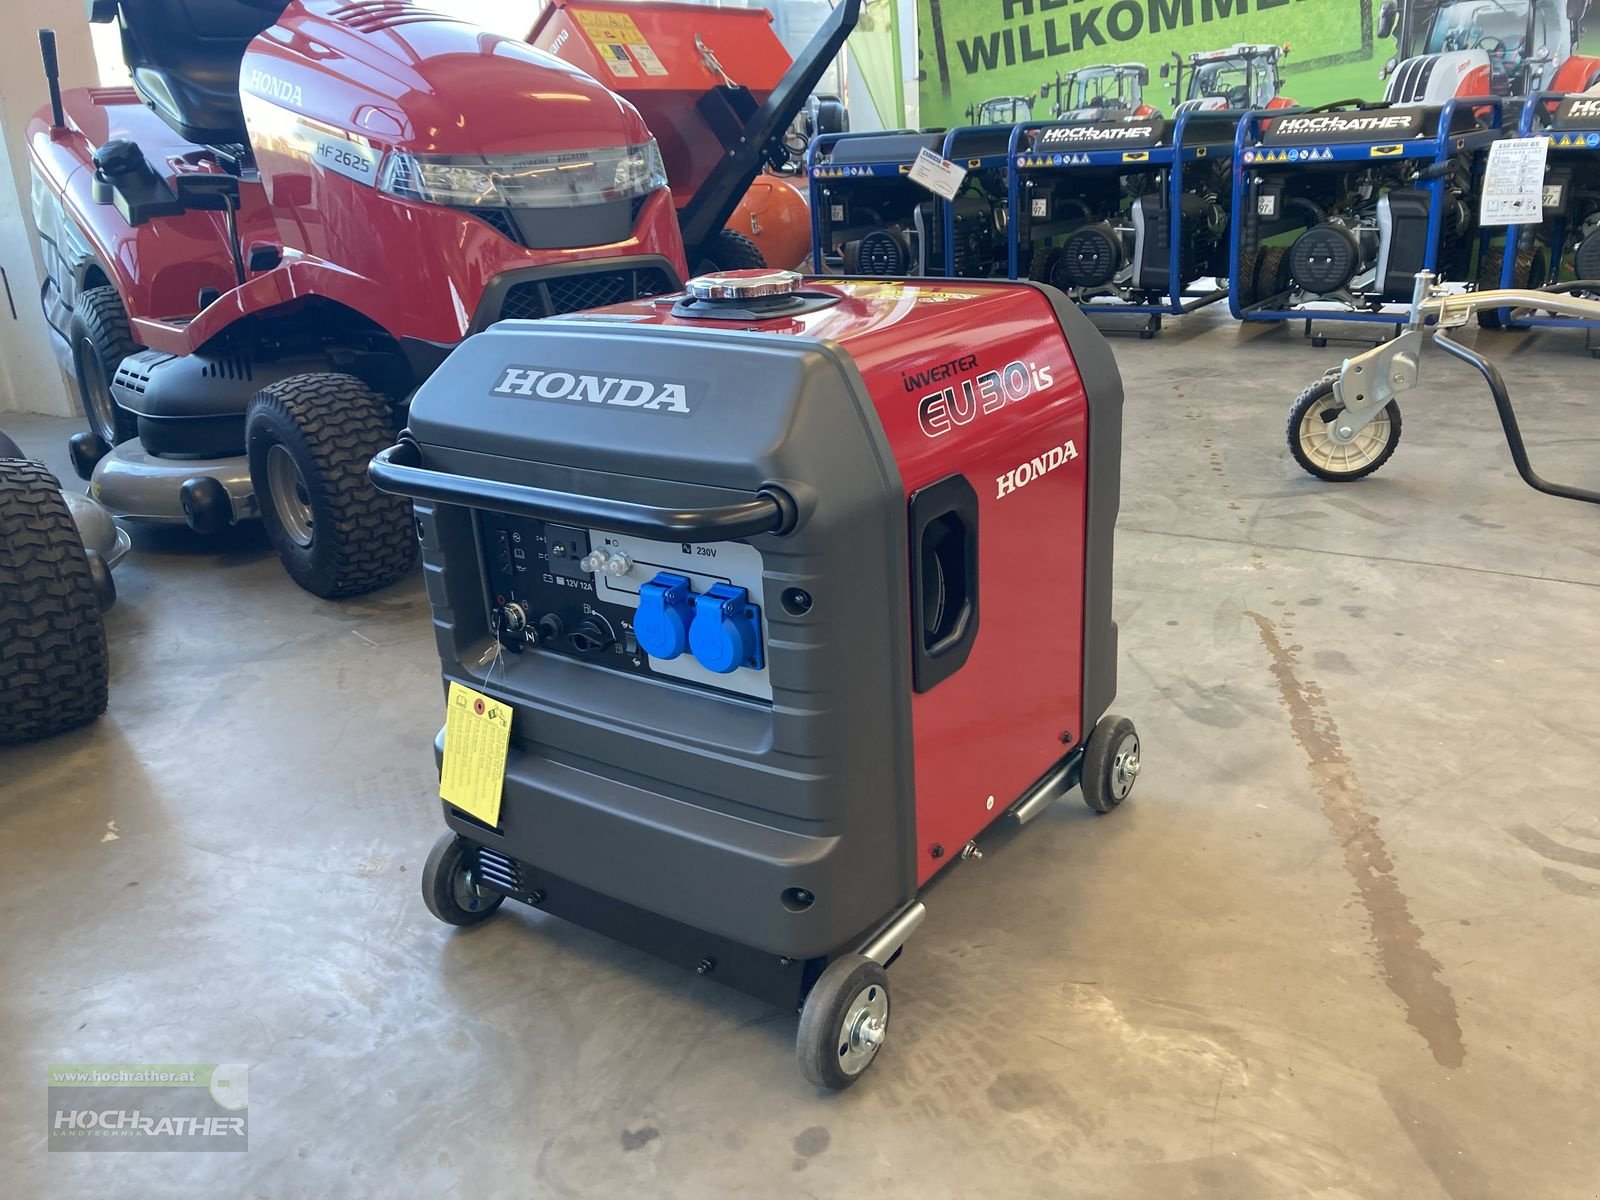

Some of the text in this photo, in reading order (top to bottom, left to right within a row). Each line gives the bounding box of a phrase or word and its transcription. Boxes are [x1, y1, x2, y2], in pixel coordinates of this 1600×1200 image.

[956, 0, 1305, 75] WILLKOMM
[252, 69, 303, 107] HONDA
[1044, 126, 1153, 141] HOCHRATHER
[1278, 115, 1412, 131] HOCHRATHER
[493, 368, 691, 414] HONDA
[996, 439, 1079, 500] HONDA
[696, 546, 717, 558] 230V
[565, 578, 593, 592] 12V 12A
